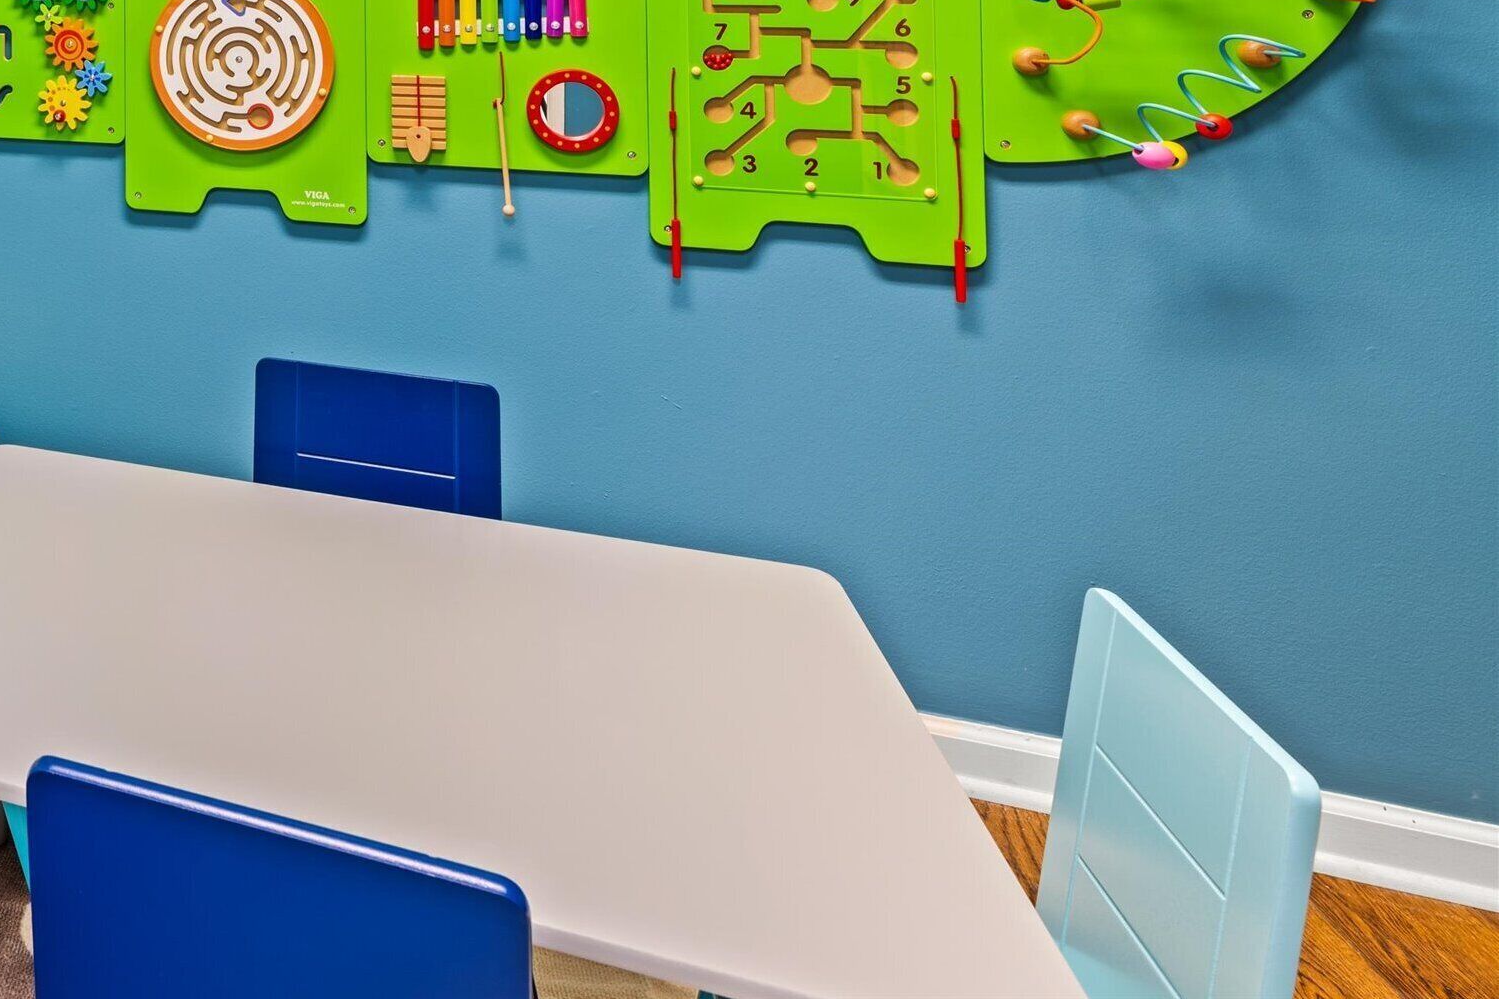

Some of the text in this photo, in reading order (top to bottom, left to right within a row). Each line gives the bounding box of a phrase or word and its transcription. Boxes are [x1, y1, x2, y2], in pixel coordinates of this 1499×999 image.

[713, 22, 728, 41] 7
[894, 18, 911, 37] 6
[895, 75, 912, 95] 5
[739, 101, 757, 119] 4
[742, 154, 758, 174] 3
[804, 157, 819, 177] 2
[872, 161, 883, 180] 1
[304, 190, 330, 200] VIGA
